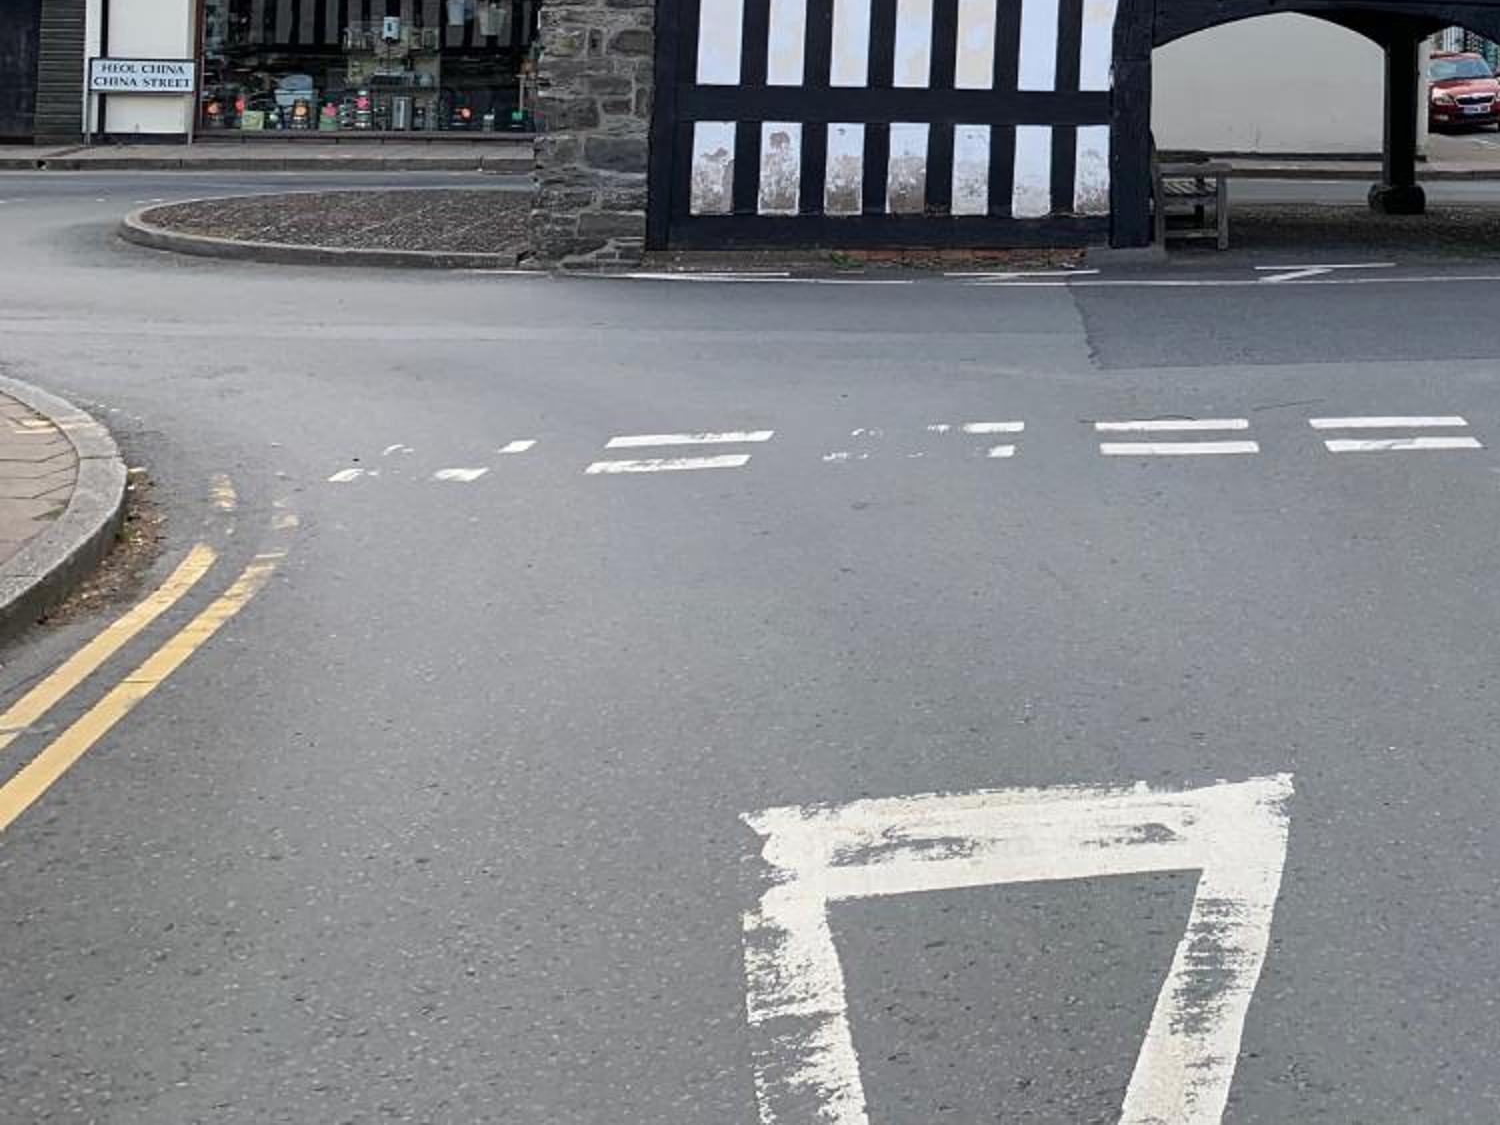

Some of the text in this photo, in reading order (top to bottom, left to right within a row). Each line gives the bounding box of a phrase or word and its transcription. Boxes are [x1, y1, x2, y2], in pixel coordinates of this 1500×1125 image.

[101, 63, 185, 75] HEOL CHINA
[93, 76, 190, 88] CHINA STREET
